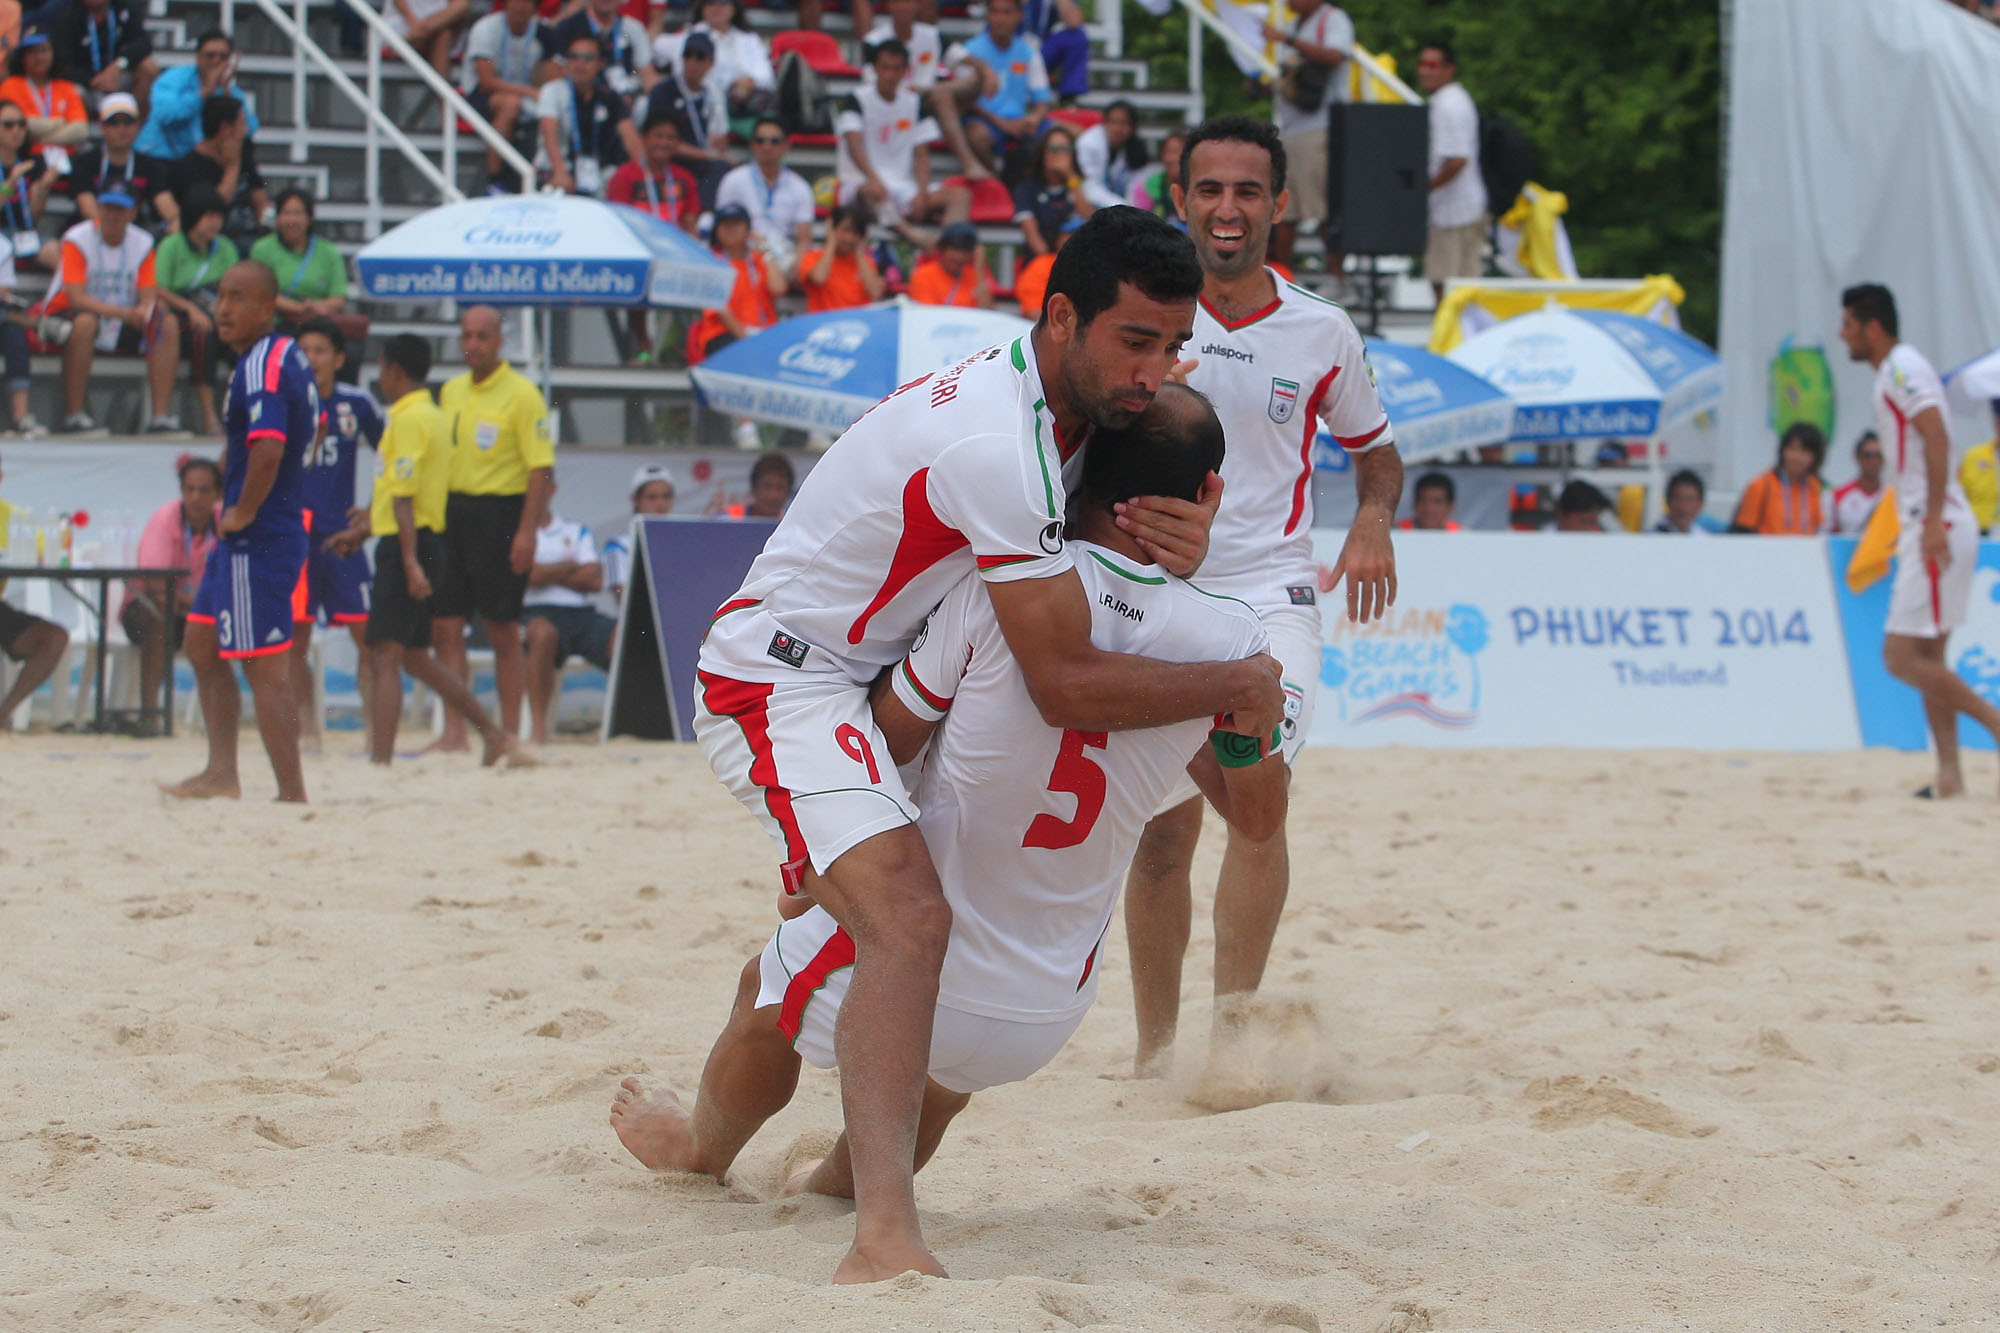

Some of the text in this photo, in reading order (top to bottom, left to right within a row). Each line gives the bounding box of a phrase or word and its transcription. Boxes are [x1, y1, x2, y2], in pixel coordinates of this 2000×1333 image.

[463, 222, 563, 247] Chang
[779, 343, 857, 382] Chang
[1201, 344, 1254, 364] uhlsport
[219, 610, 232, 647] 3
[1508, 605, 1812, 648] PHUKET 2014
[1351, 640, 1450, 668] BEACH
[1351, 671, 1460, 699] GAMES
[1610, 660, 1729, 686] Thailand
[834, 722, 881, 785] 9
[1021, 727, 1108, 850] 5
